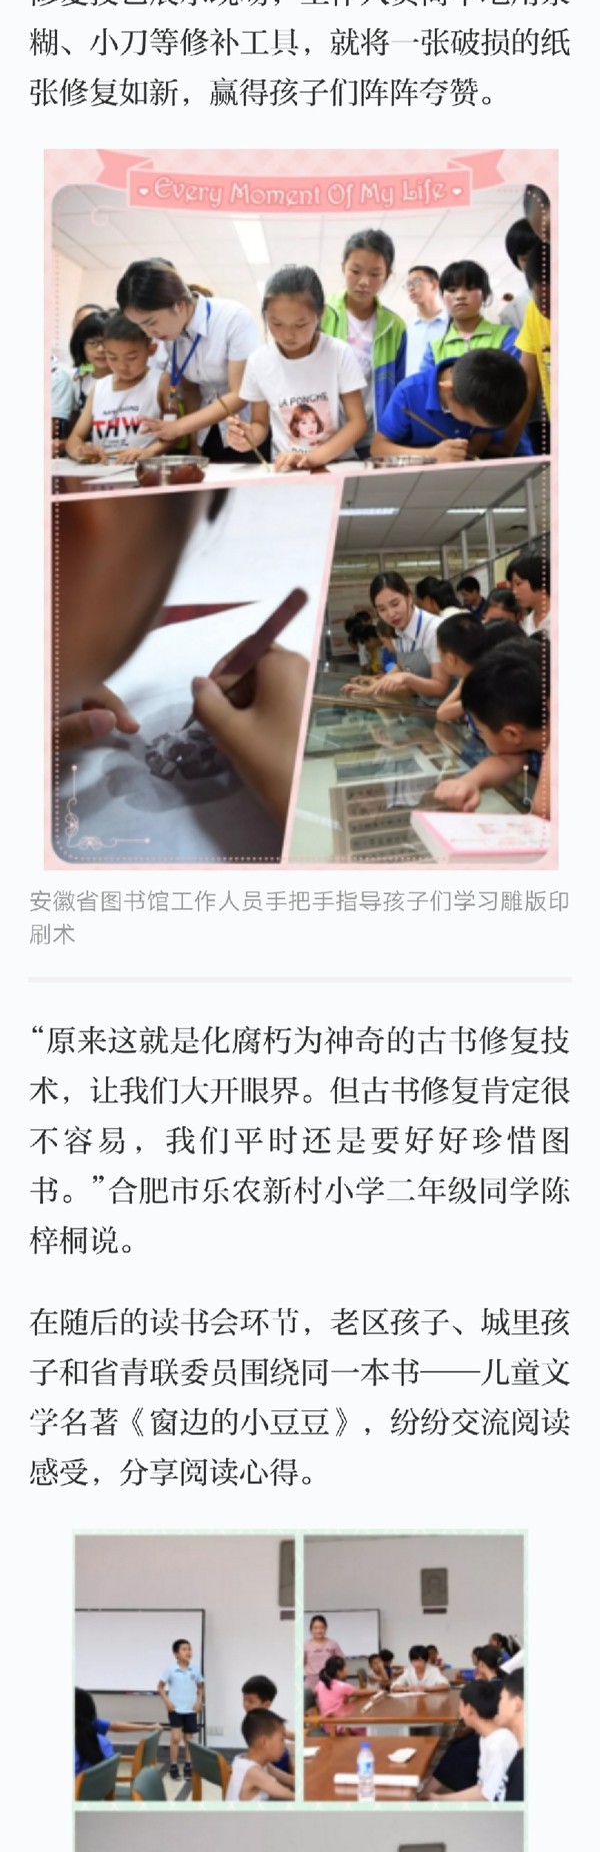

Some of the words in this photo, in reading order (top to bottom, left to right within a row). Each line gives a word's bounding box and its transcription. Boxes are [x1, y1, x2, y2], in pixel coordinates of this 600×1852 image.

[29, 28, 570, 57] 糊、小刀等修补工具，就将一张破损的纸
[30, 77, 491, 106] 张修复如新，赢得孩子们阵阵夸赞。
[30, 890, 568, 912] 安徽省图书馆工作人员手把手指导孩子们学习雕版印
[30, 924, 75, 945] 刷术
[30, 1076, 570, 1105] 术，让我们大开眼界。但古书修复肯定很
[30, 1126, 569, 1155] 不容易，我们平时还是要好好珍惜图
[30, 1175, 570, 1204] 书。”合肥市乐农新村小学二年级同学陈
[30, 1226, 131, 1255] 梓桐说。
[30, 1308, 570, 1336] 在随后的读书会环节，老区孩子、城里孩
[30, 1407, 570, 1437] 学名著《窗边的小豆豆》，纷纷交流阅读
[30, 1457, 311, 1486] 感受，分享阅读心得。
